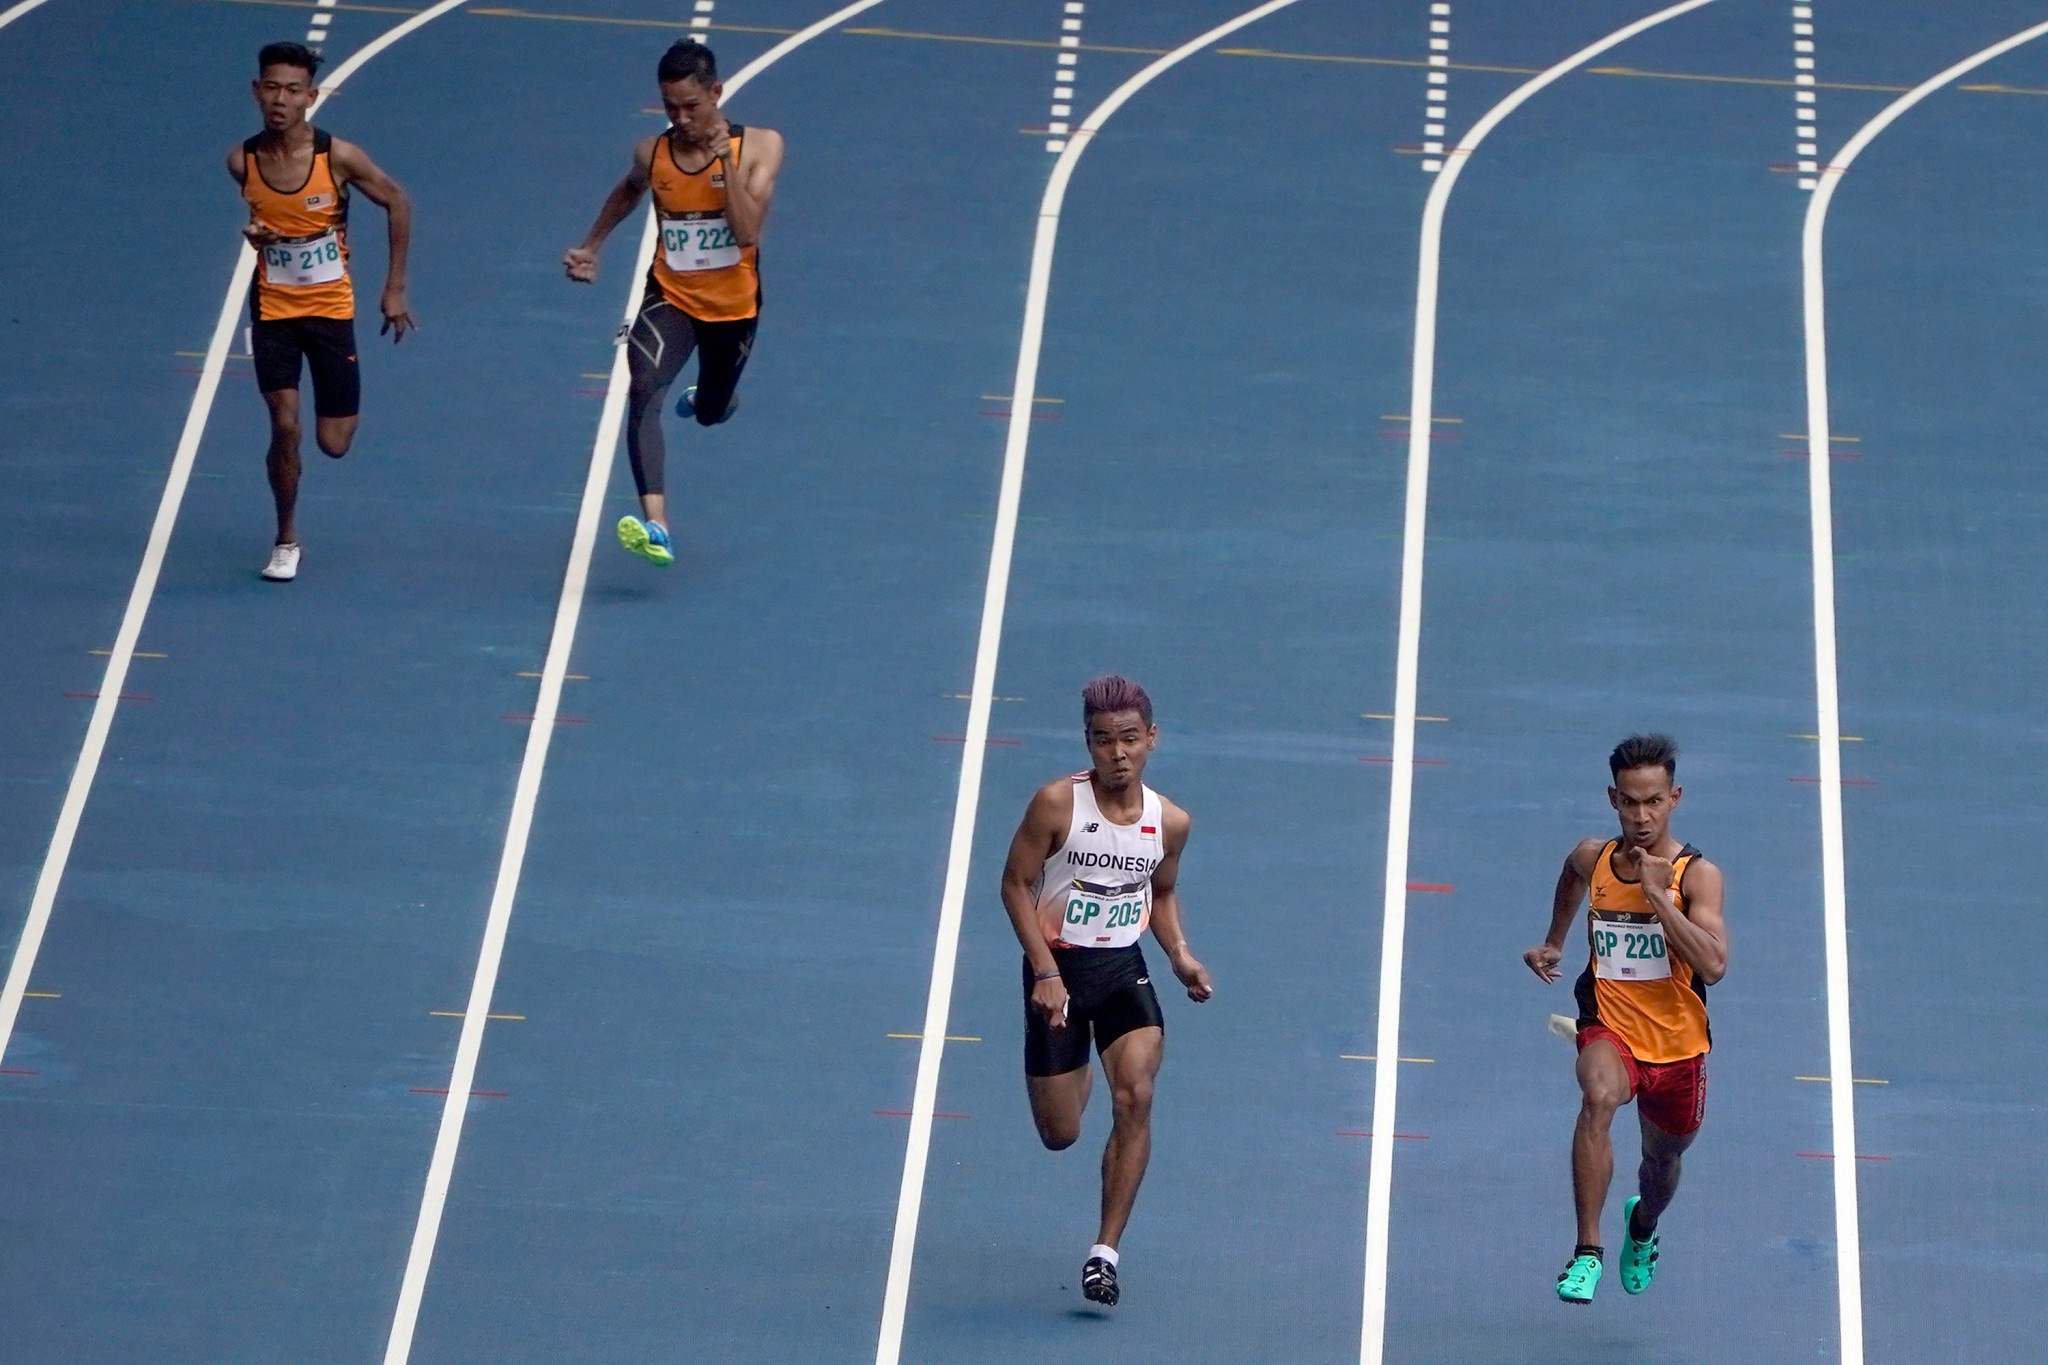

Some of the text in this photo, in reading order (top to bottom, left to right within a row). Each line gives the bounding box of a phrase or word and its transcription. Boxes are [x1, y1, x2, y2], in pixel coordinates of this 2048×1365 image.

[665, 229, 688, 251] CP
[266, 242, 339, 270] CP 218
[1067, 851, 1156, 872] INDONESIA
[1065, 898, 1142, 928] CP 205
[1594, 929, 1667, 960] CP 220
